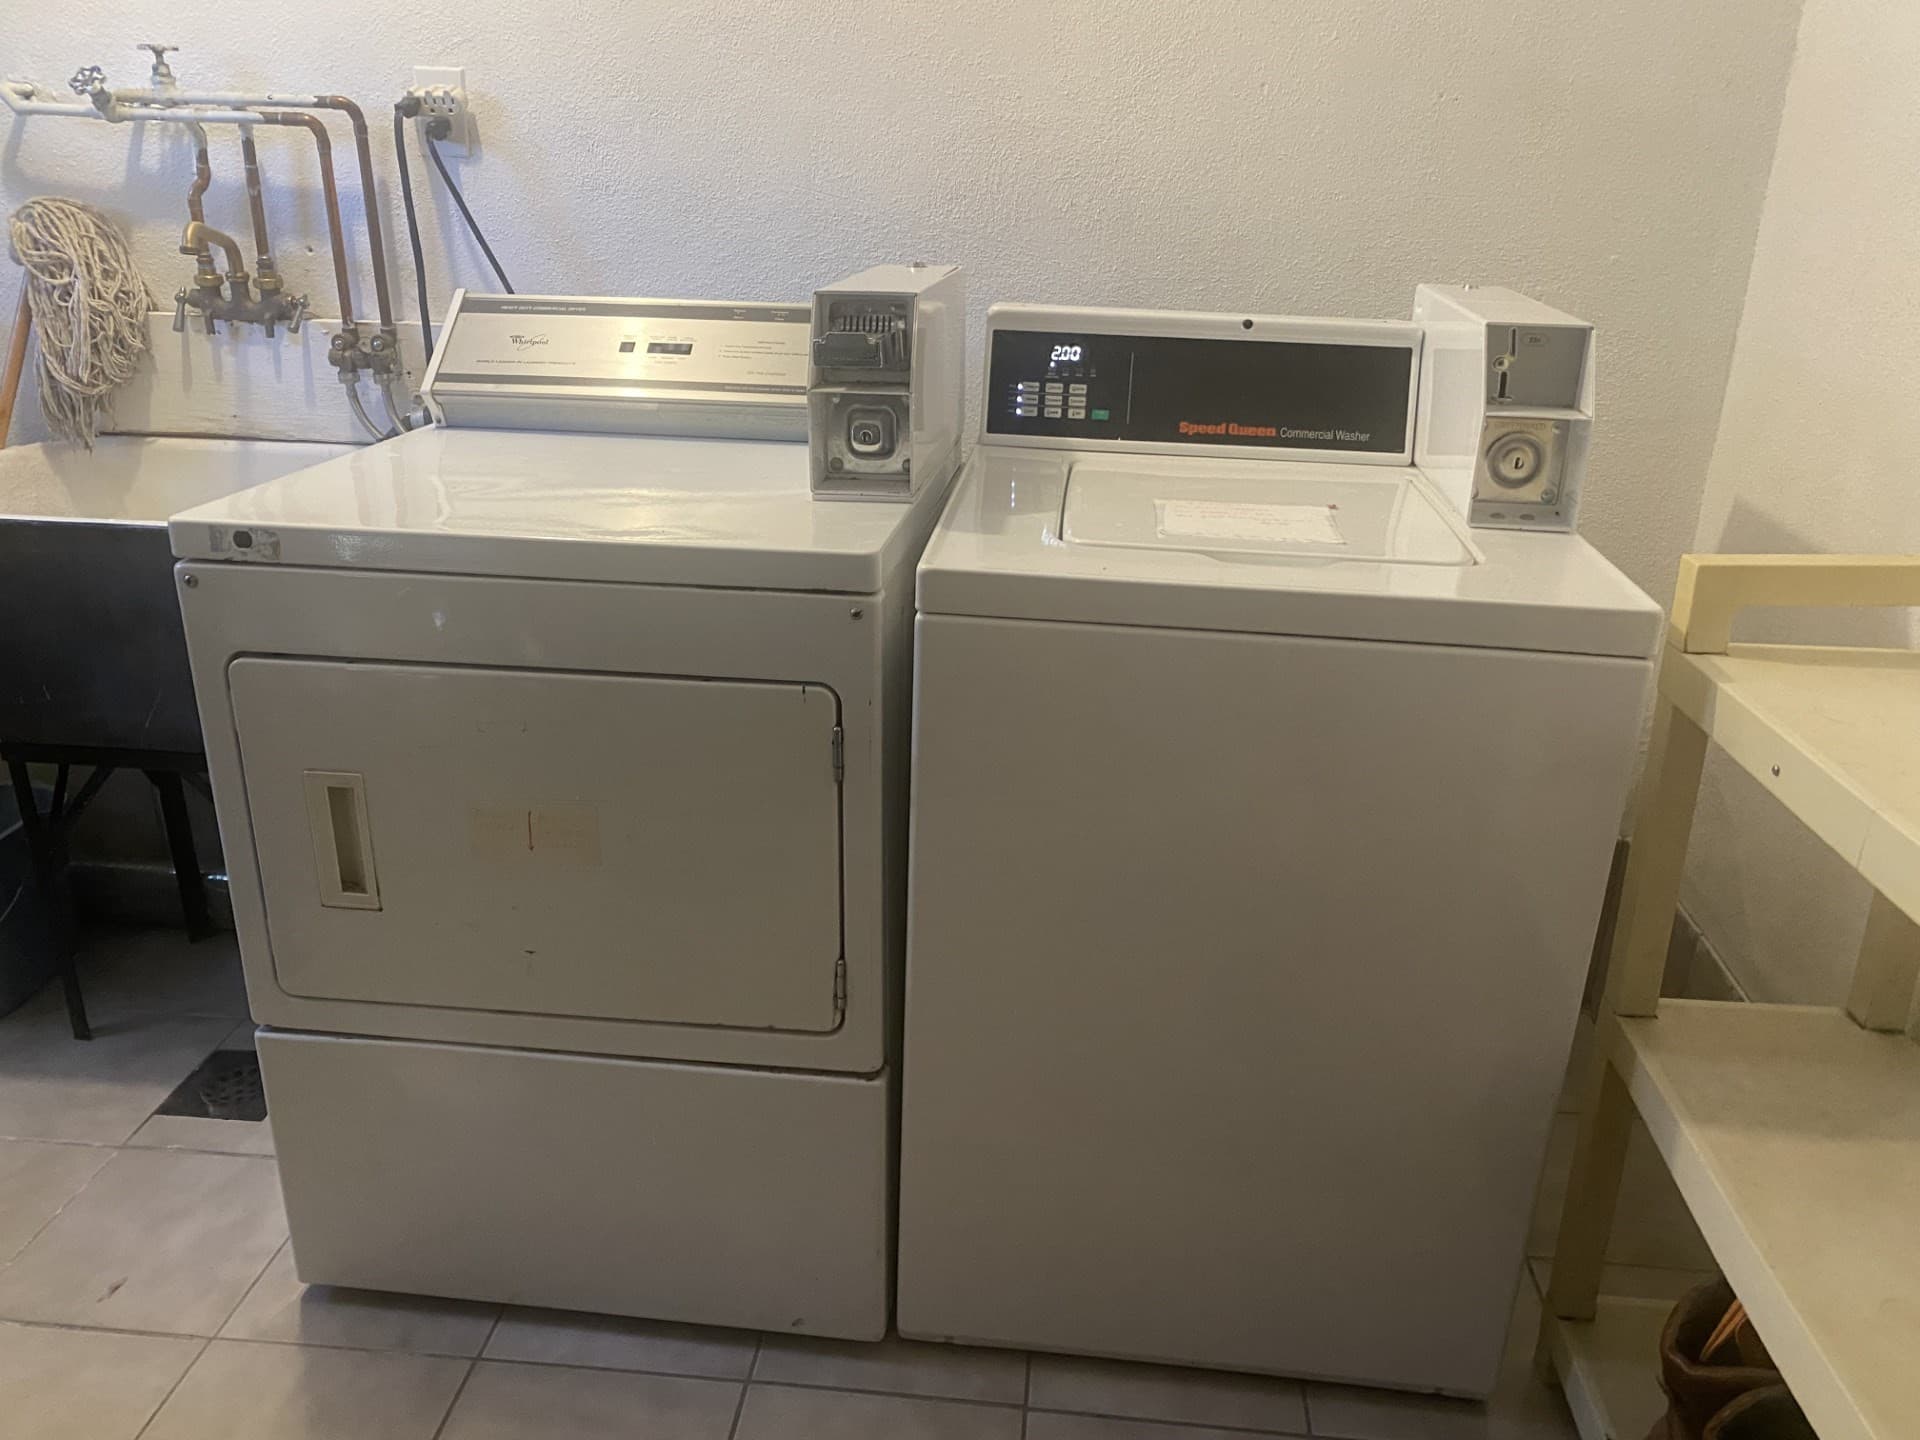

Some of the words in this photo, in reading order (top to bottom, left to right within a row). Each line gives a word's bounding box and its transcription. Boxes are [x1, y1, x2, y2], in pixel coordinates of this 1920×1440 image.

[509, 335, 550, 348] Whirlpool
[1179, 421, 1225, 436] Speed
[1228, 423, 1277, 437] Queen
[1279, 427, 1334, 440] Commercial
[1335, 429, 1371, 442] Washer
